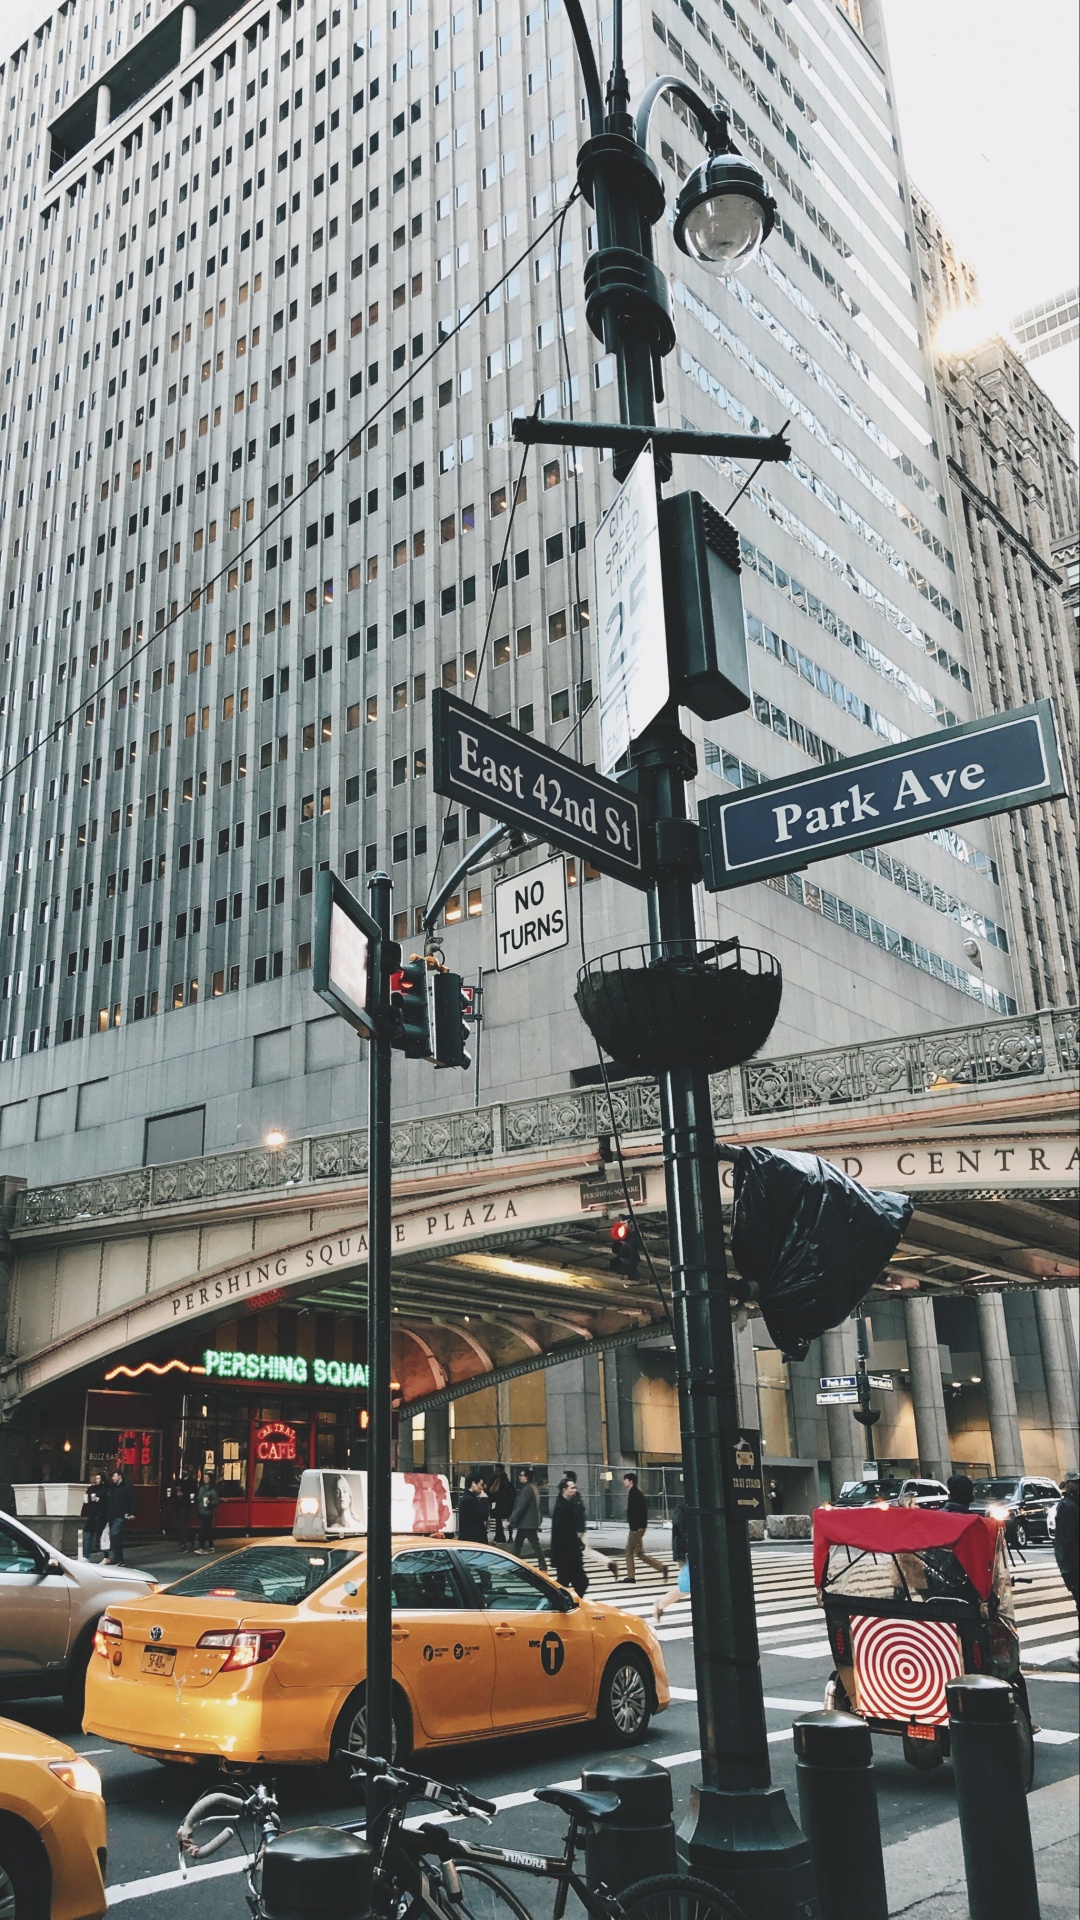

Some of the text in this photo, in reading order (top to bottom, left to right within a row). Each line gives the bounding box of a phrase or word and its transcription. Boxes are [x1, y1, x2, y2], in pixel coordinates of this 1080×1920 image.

[609, 487, 632, 538] CITY
[605, 509, 639, 574] SPEED
[610, 543, 639, 597] LIMIT
[605, 562, 647, 684] 25
[458, 730, 632, 851] East 42nd St
[771, 763, 986, 843] Park Ave
[514, 880, 545, 914] NO
[500, 909, 564, 955] TURNS
[582, 1189, 613, 1200] PERSHING
[172, 1199, 518, 1315] PERSHING SQUAE PLAZA
[204, 1349, 369, 1388] PERSHING SQUA
[89, 1452, 105, 1461] BUZZ
[733, 1477, 761, 1488] TAXI STAND
[502, 1850, 547, 1870] TUNDRA
